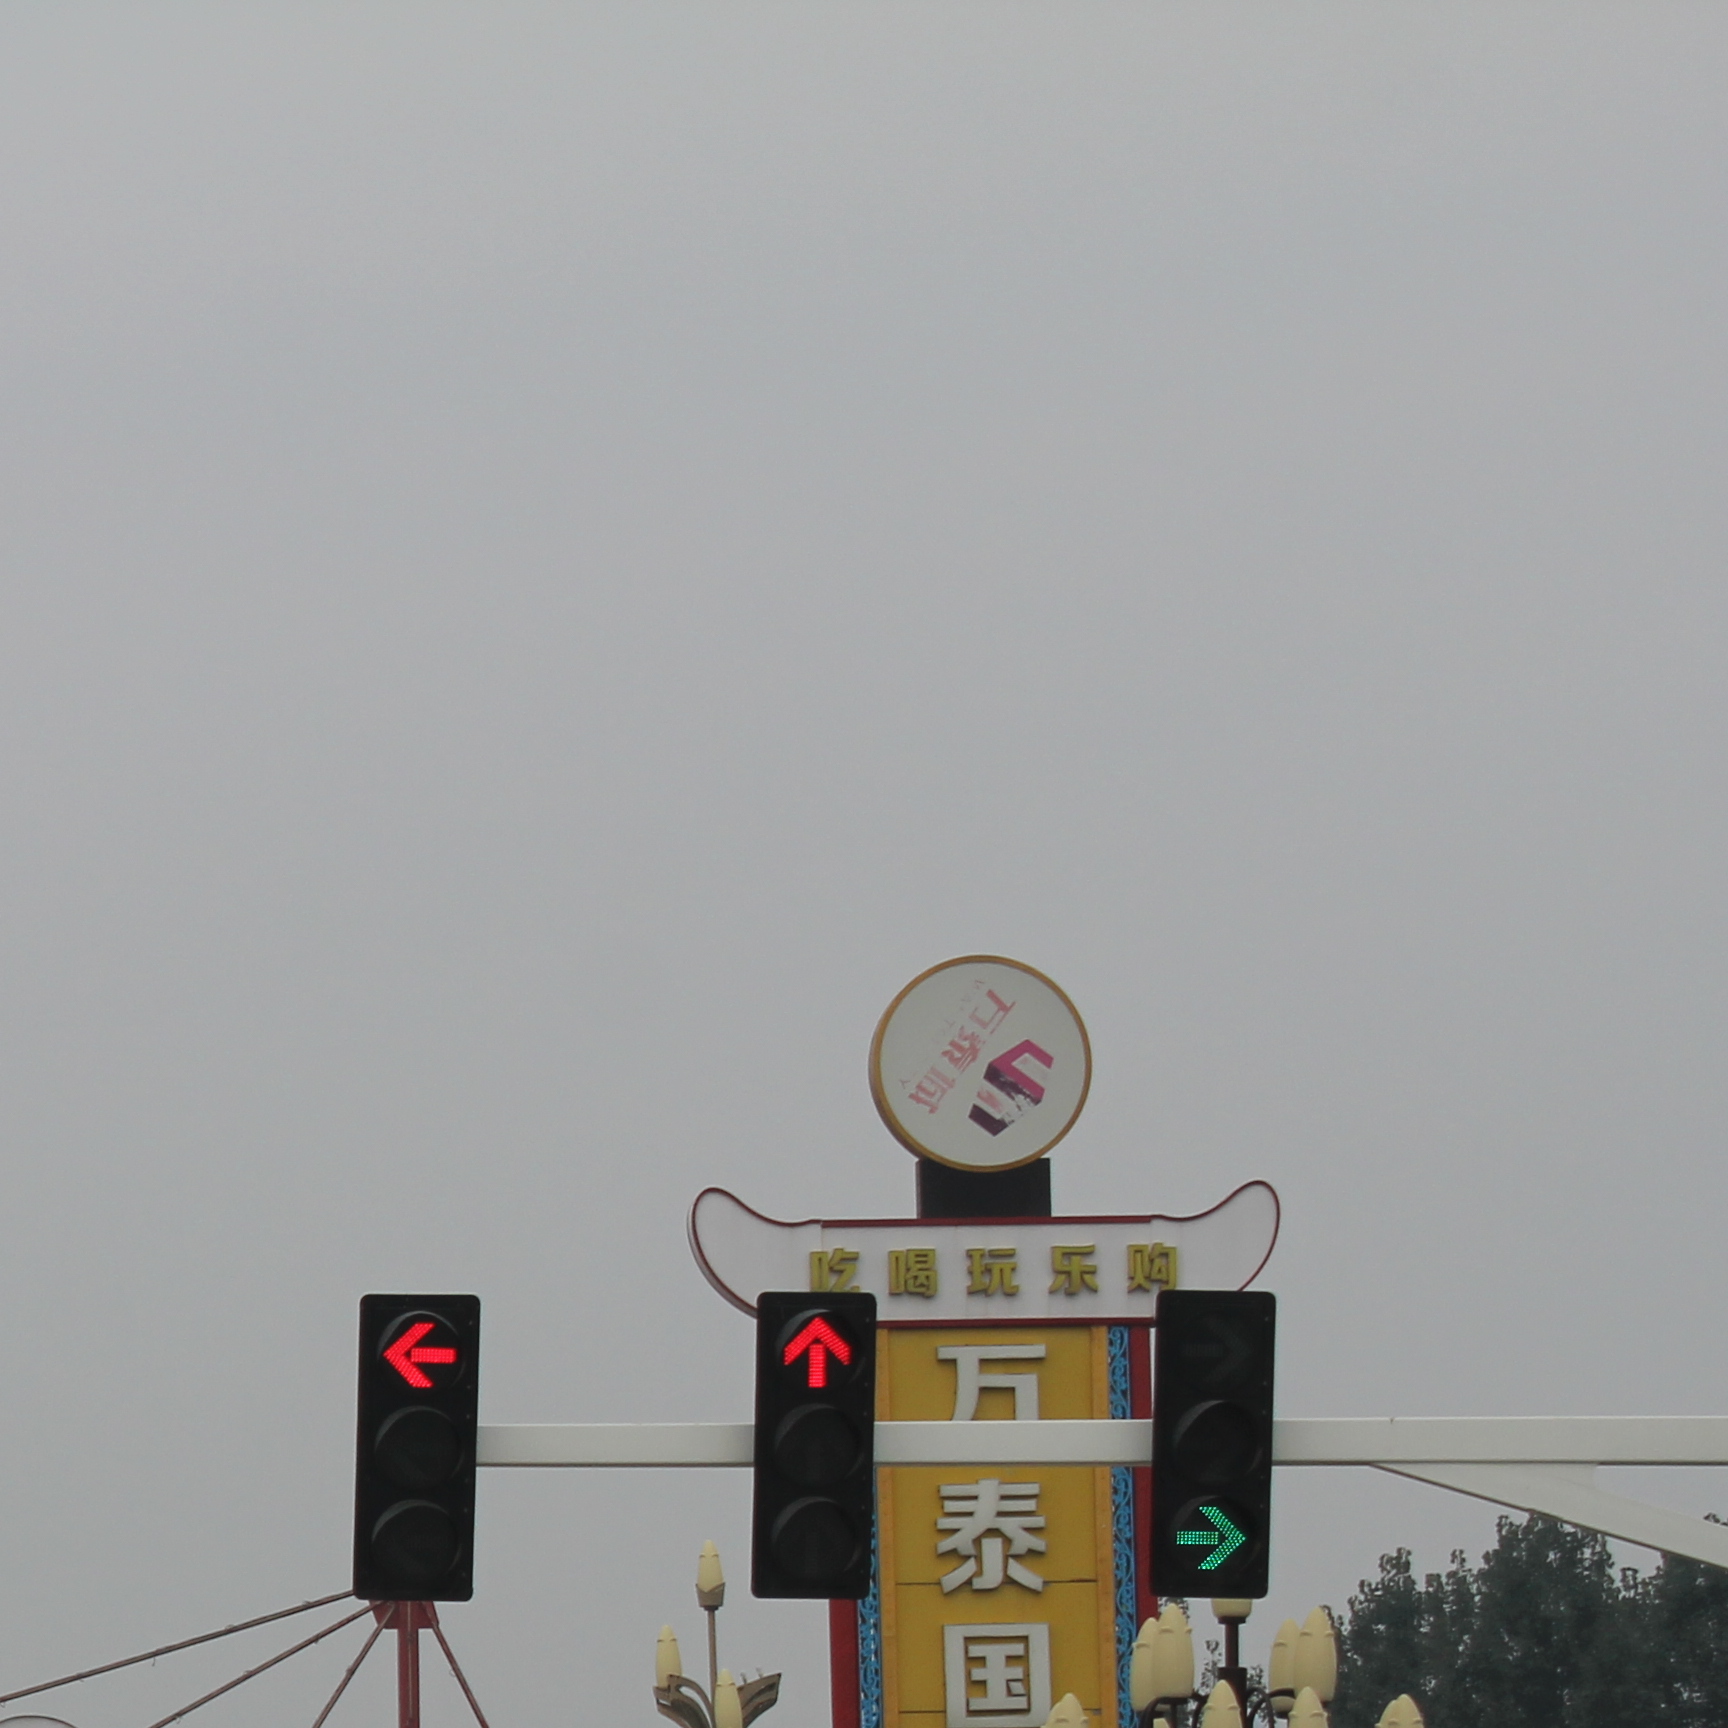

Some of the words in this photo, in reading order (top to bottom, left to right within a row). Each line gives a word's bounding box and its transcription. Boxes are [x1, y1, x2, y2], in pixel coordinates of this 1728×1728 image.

[809, 1241, 1179, 1299] 吃喝玩乐购
